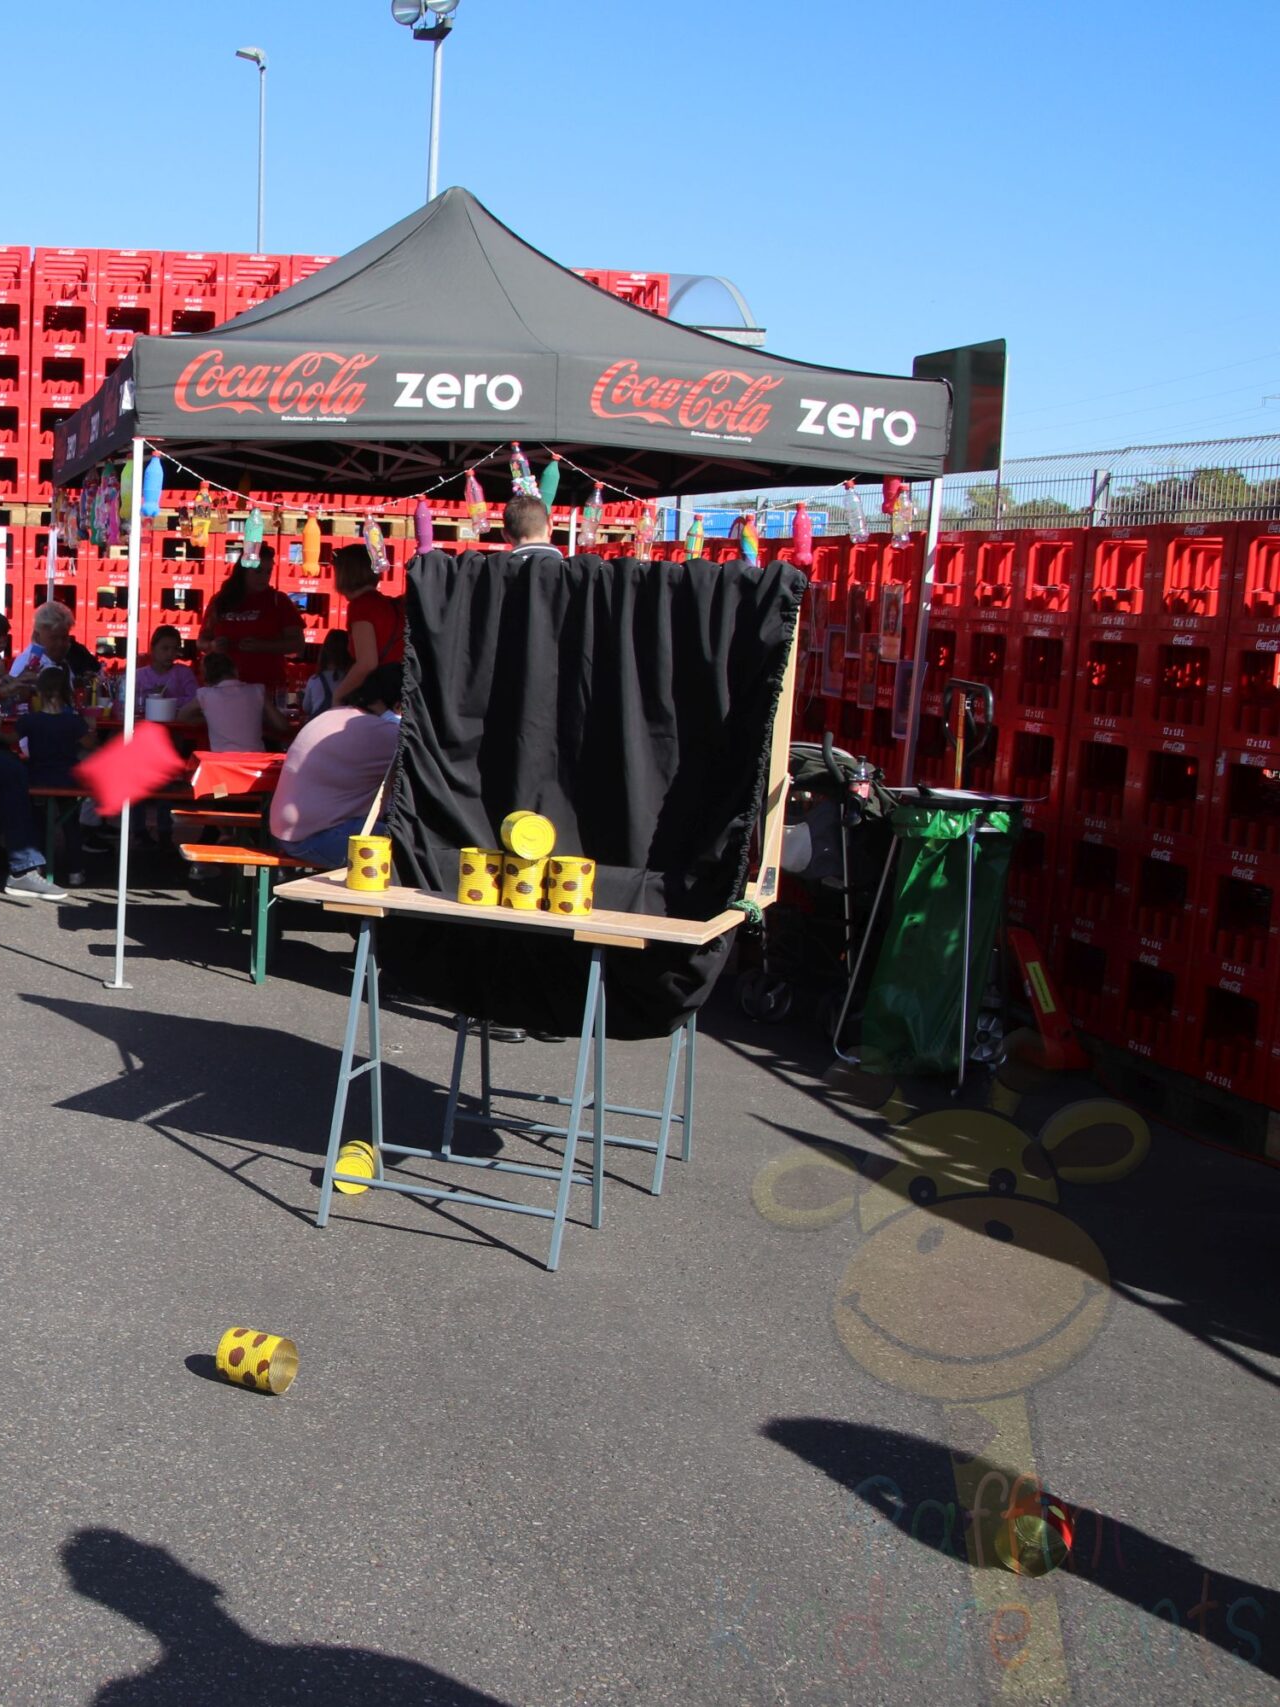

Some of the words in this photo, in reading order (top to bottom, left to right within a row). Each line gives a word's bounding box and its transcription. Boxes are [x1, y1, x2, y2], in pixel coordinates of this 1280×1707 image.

[174, 350, 379, 414] Coca-Cola
[393, 372, 522, 411] zero
[590, 359, 784, 434] Coca-Cola
[796, 398, 916, 446] zero
